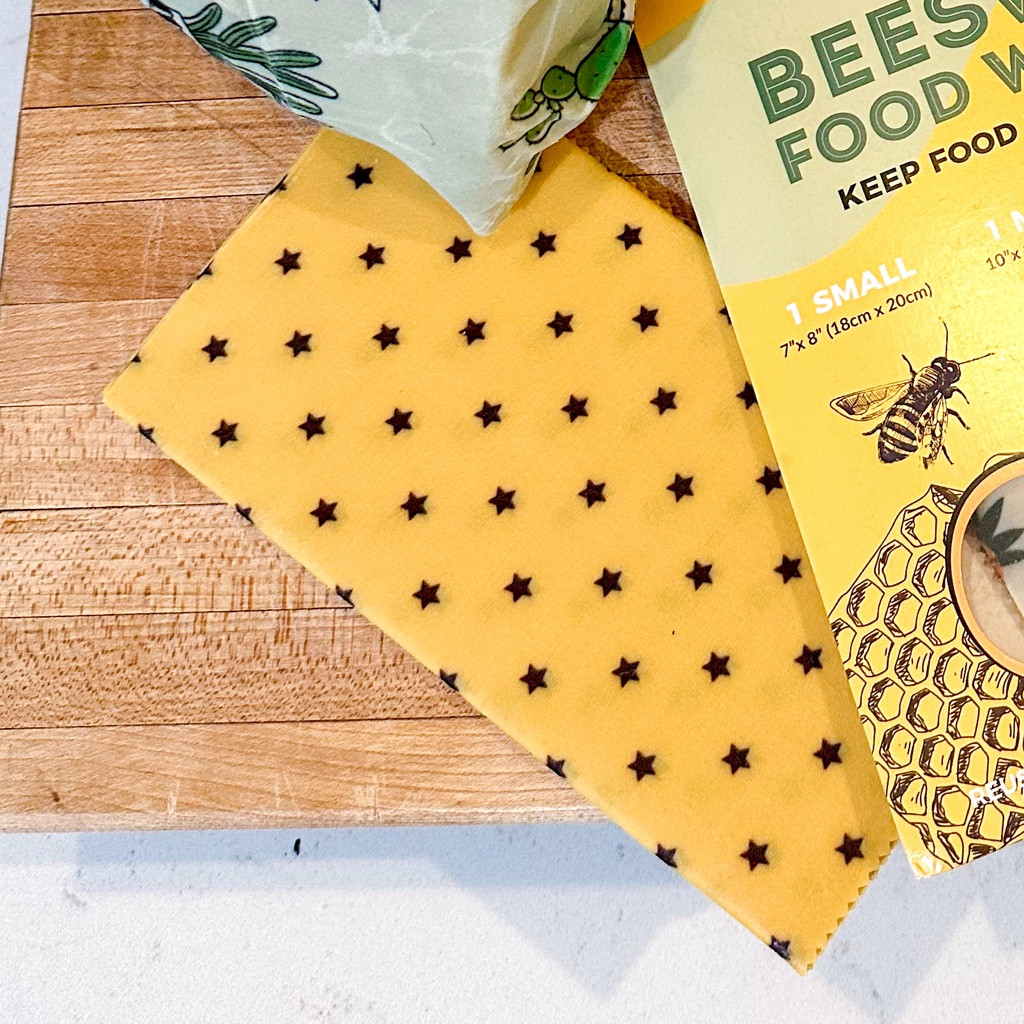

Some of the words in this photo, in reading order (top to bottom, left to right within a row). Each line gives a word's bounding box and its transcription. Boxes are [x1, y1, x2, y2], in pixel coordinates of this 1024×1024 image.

[776, 71, 970, 184] FOOD
[837, 159, 920, 210] KEEP
[928, 122, 1018, 173] FOOD
[985, 219, 1001, 241] 1
[786, 303, 803, 325] 1
[812, 257, 917, 315] SMALL
[825, 311, 872, 341] (18cm
[886, 283, 933, 314] 20cm)
